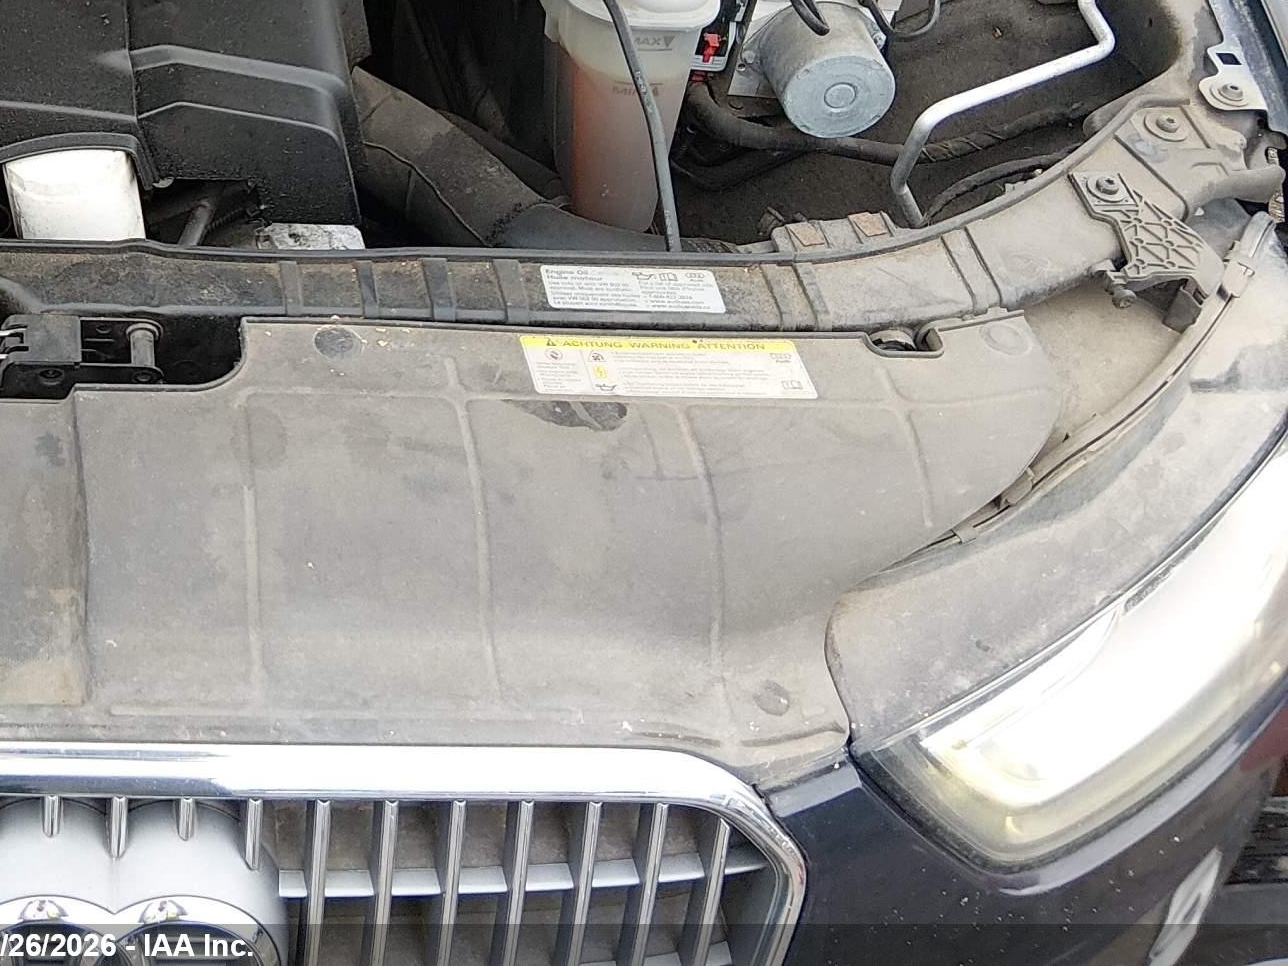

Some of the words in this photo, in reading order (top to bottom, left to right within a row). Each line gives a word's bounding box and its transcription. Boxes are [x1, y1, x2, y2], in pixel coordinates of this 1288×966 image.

[561, 339, 624, 348] ACHTUNG
[629, 341, 691, 350] WARNING
[697, 341, 766, 351] ATTENTION
